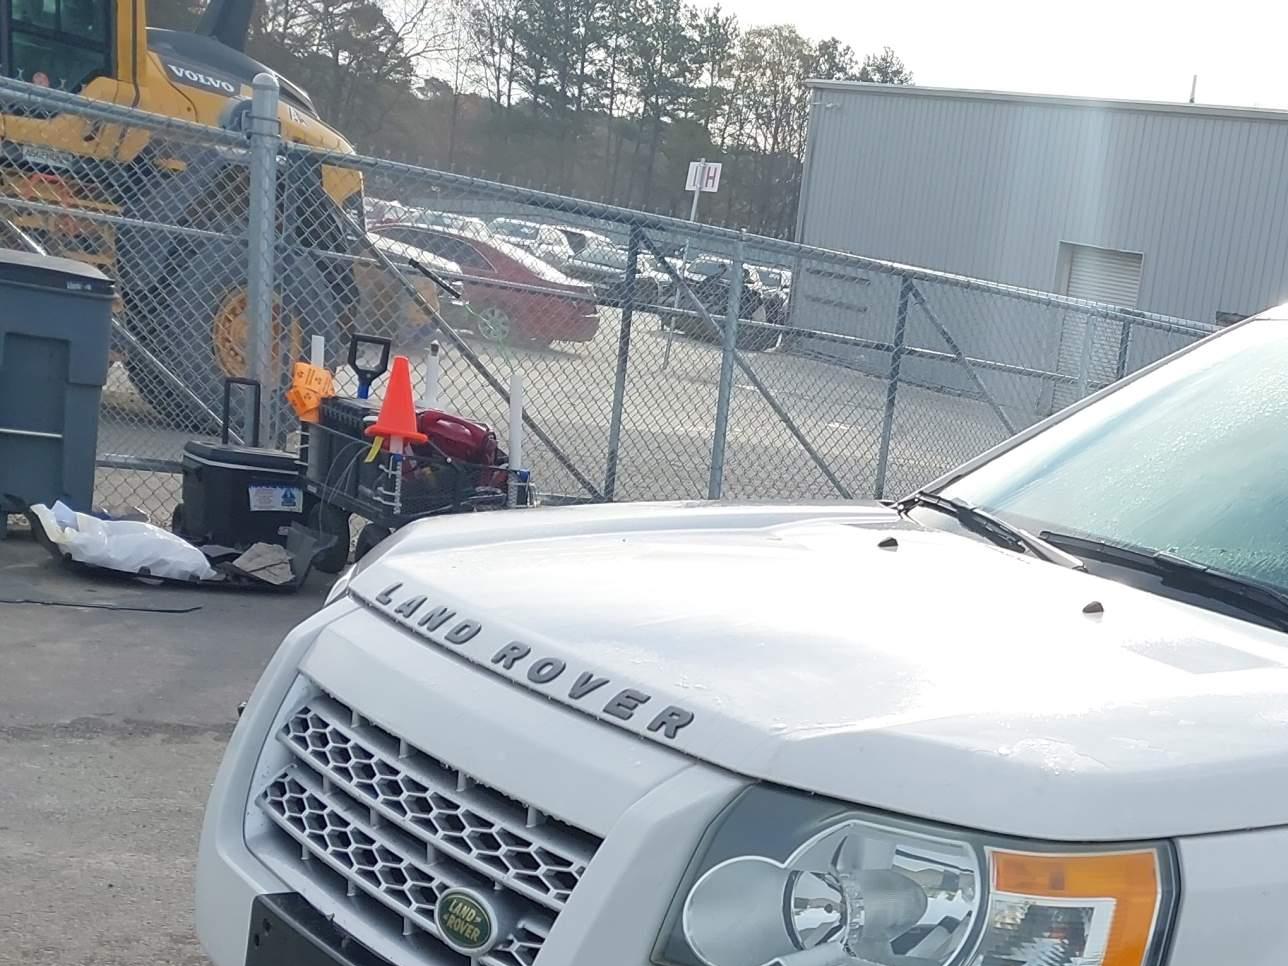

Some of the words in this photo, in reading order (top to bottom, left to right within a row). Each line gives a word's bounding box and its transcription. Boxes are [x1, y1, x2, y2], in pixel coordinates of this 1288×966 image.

[167, 63, 235, 93] VOLVO
[375, 582, 482, 645] LAND
[490, 640, 695, 739] ROVER
[448, 899, 477, 922] LAND
[446, 913, 480, 942] ROVER
